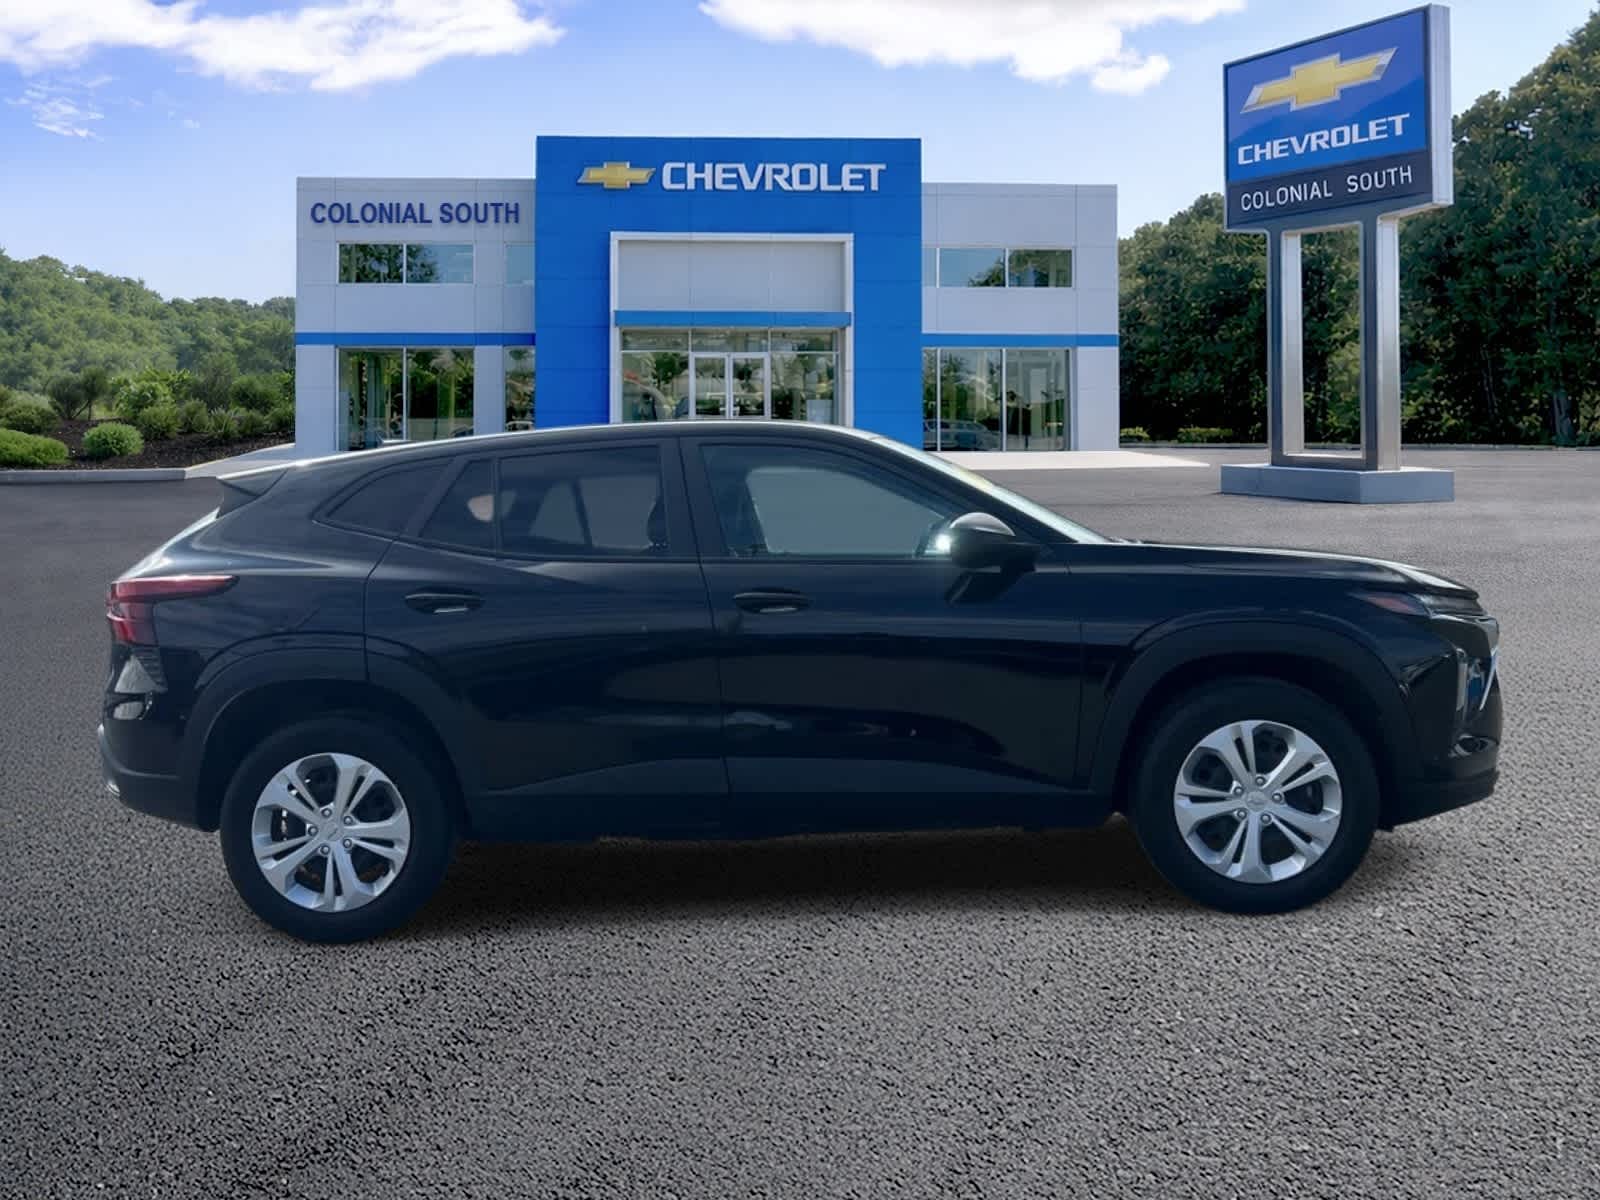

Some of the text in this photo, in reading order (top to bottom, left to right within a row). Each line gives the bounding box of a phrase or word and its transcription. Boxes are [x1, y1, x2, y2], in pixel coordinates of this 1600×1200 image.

[1238, 113, 1410, 165] CHEVROLET
[661, 162, 886, 191] CHEVROLET
[1241, 165, 1412, 211] COLONIAL SOUTH
[310, 202, 520, 224] COLONIAL SOUTH
